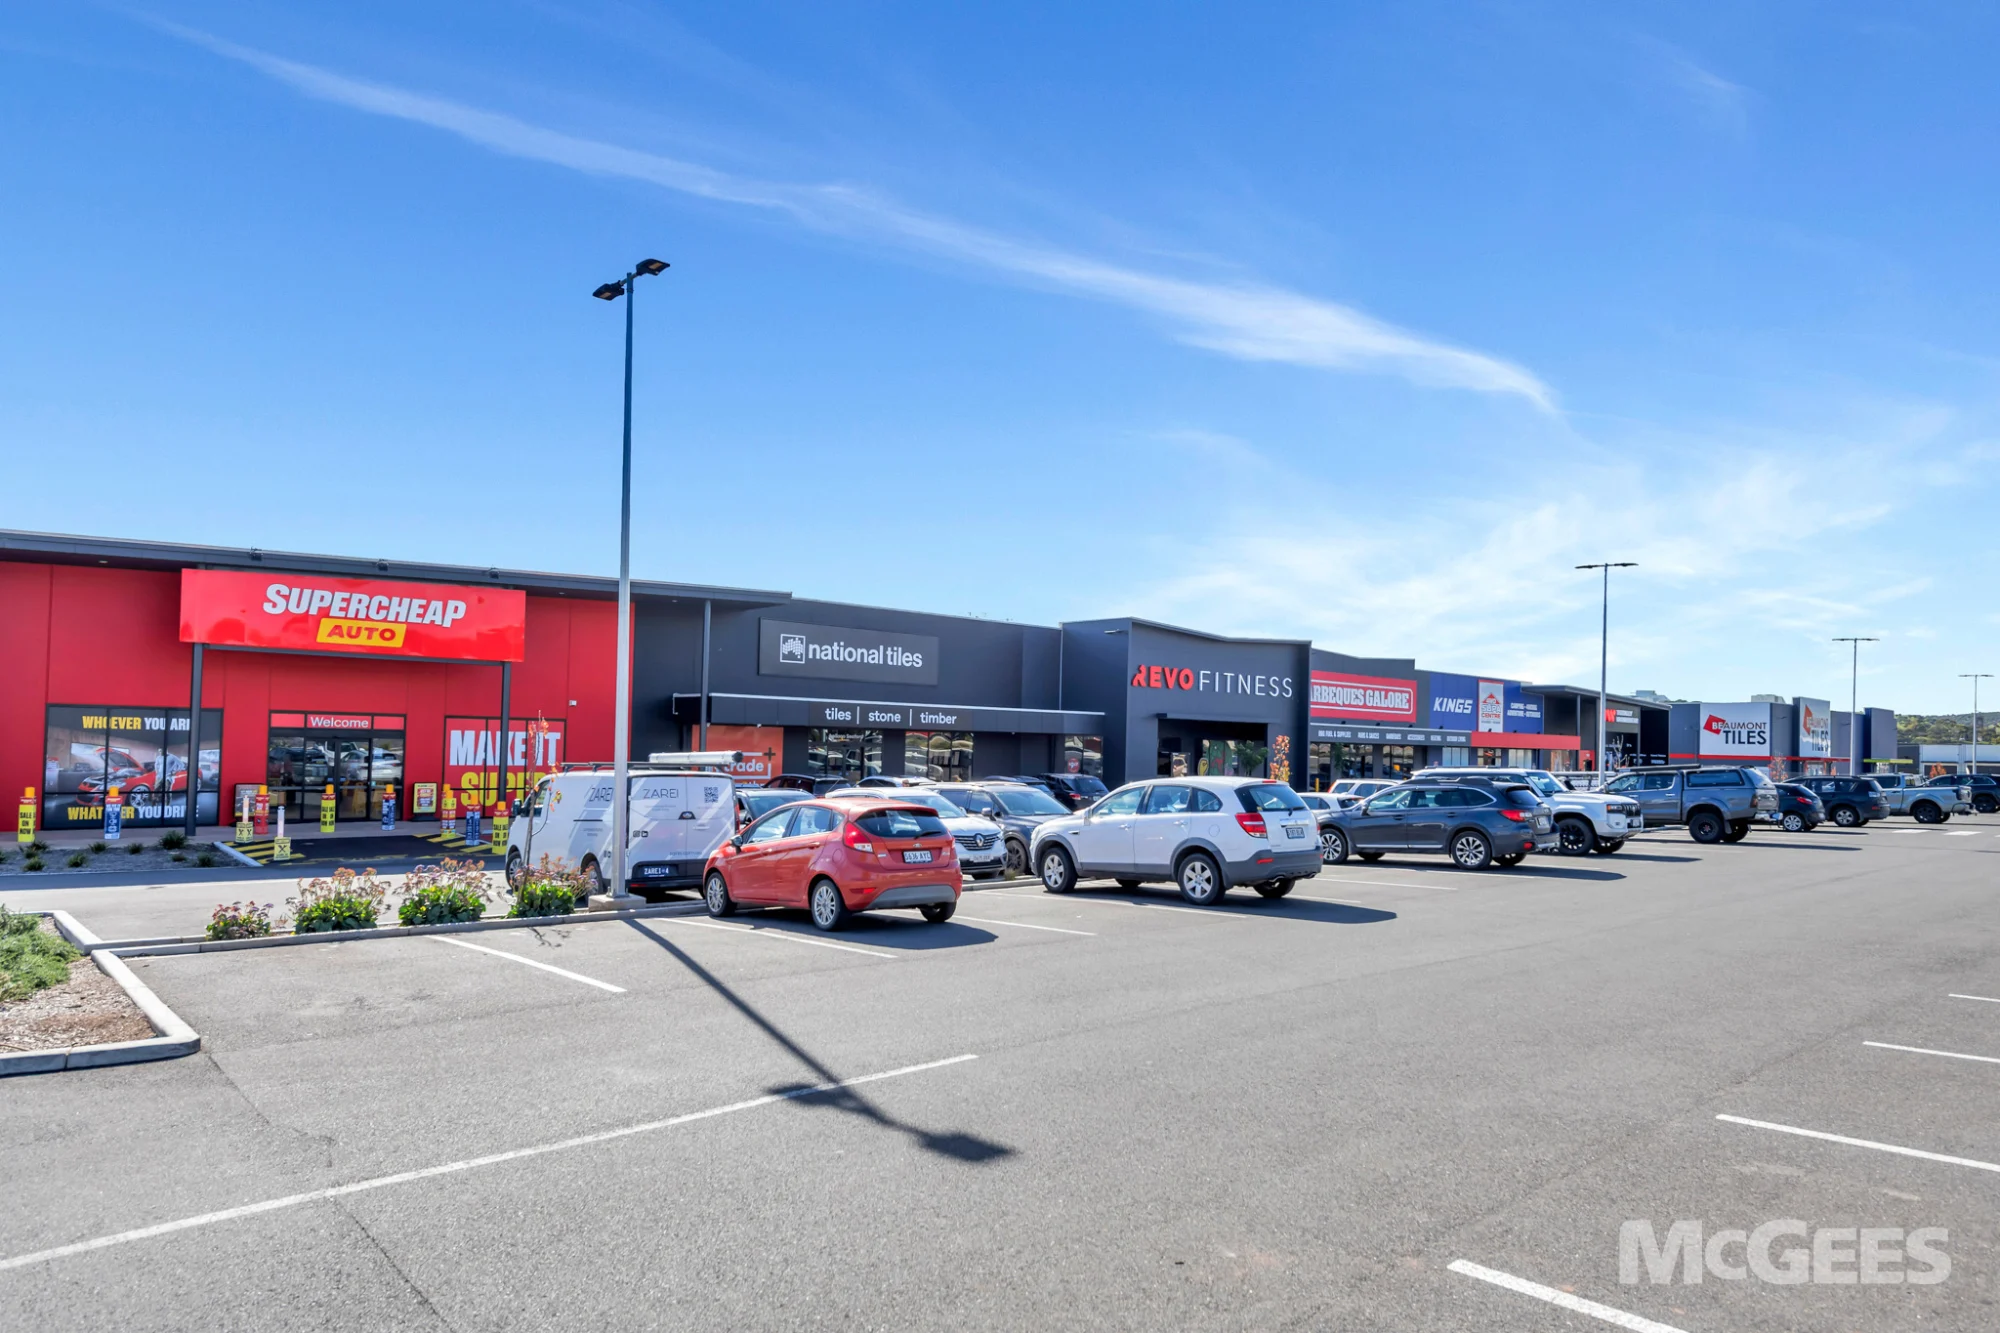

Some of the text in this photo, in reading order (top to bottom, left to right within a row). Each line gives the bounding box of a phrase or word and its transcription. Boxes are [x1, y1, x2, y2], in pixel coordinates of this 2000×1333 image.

[263, 584, 466, 627] SUPERCHEAP
[327, 624, 396, 642] AUTO
[808, 642, 923, 668] national tiles
[1132, 664, 1293, 698] REVO FITNESS
[1311, 685, 1409, 709] RBEQUES GALORE
[1433, 697, 1473, 714] KINGS
[144, 717, 166, 730] YOU
[310, 716, 369, 729] Welcome
[825, 708, 957, 724] tiles stone timber
[1711, 721, 1767, 730] BEAUMONT
[1723, 730, 1767, 745] TILES
[449, 730, 561, 767] MAKE IT
[643, 788, 679, 799] ZAREI
[67, 806, 135, 820] WHATER
[138, 805, 161, 819] YOU
[164, 805, 199, 818] DRI
